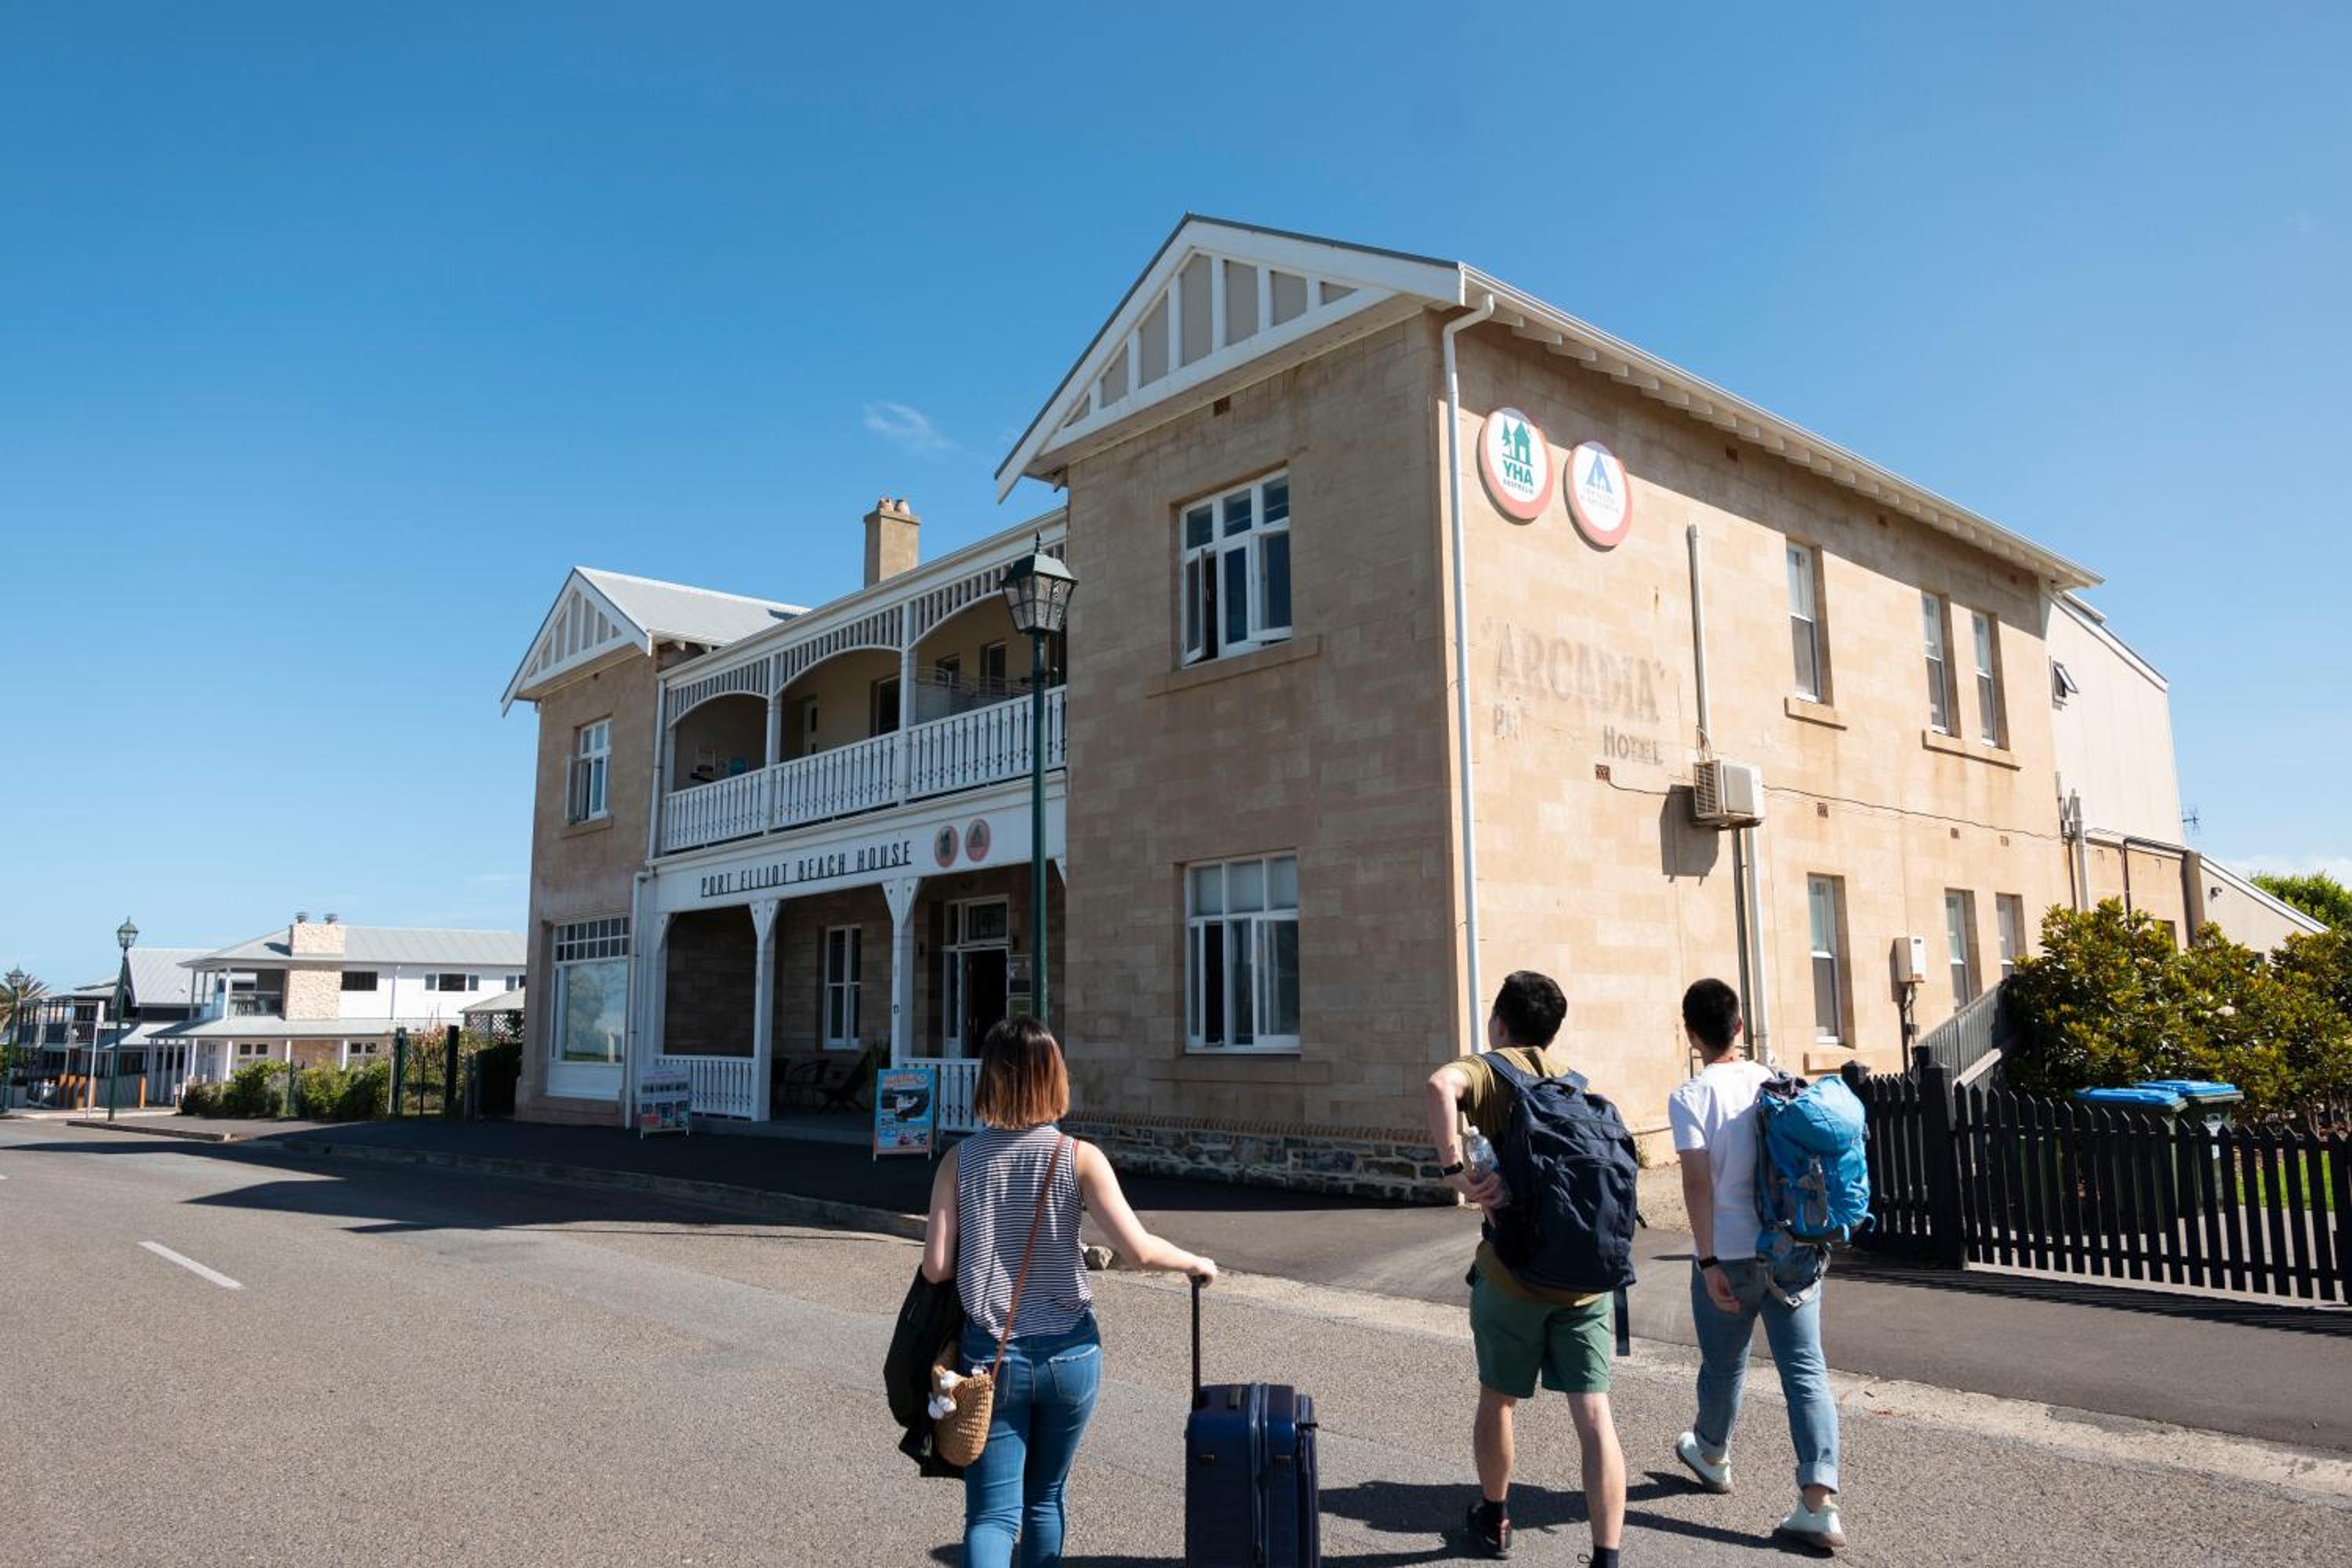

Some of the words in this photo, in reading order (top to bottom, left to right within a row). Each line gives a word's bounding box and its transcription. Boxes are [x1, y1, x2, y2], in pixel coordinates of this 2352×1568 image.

[1502, 459, 1534, 487] YHA
[1603, 724, 1664, 766] HOTEL
[701, 873, 733, 898] PORT
[740, 863, 788, 892] ELLIOT
[798, 852, 847, 882] BEACH
[857, 840, 913, 873] HOUSE
